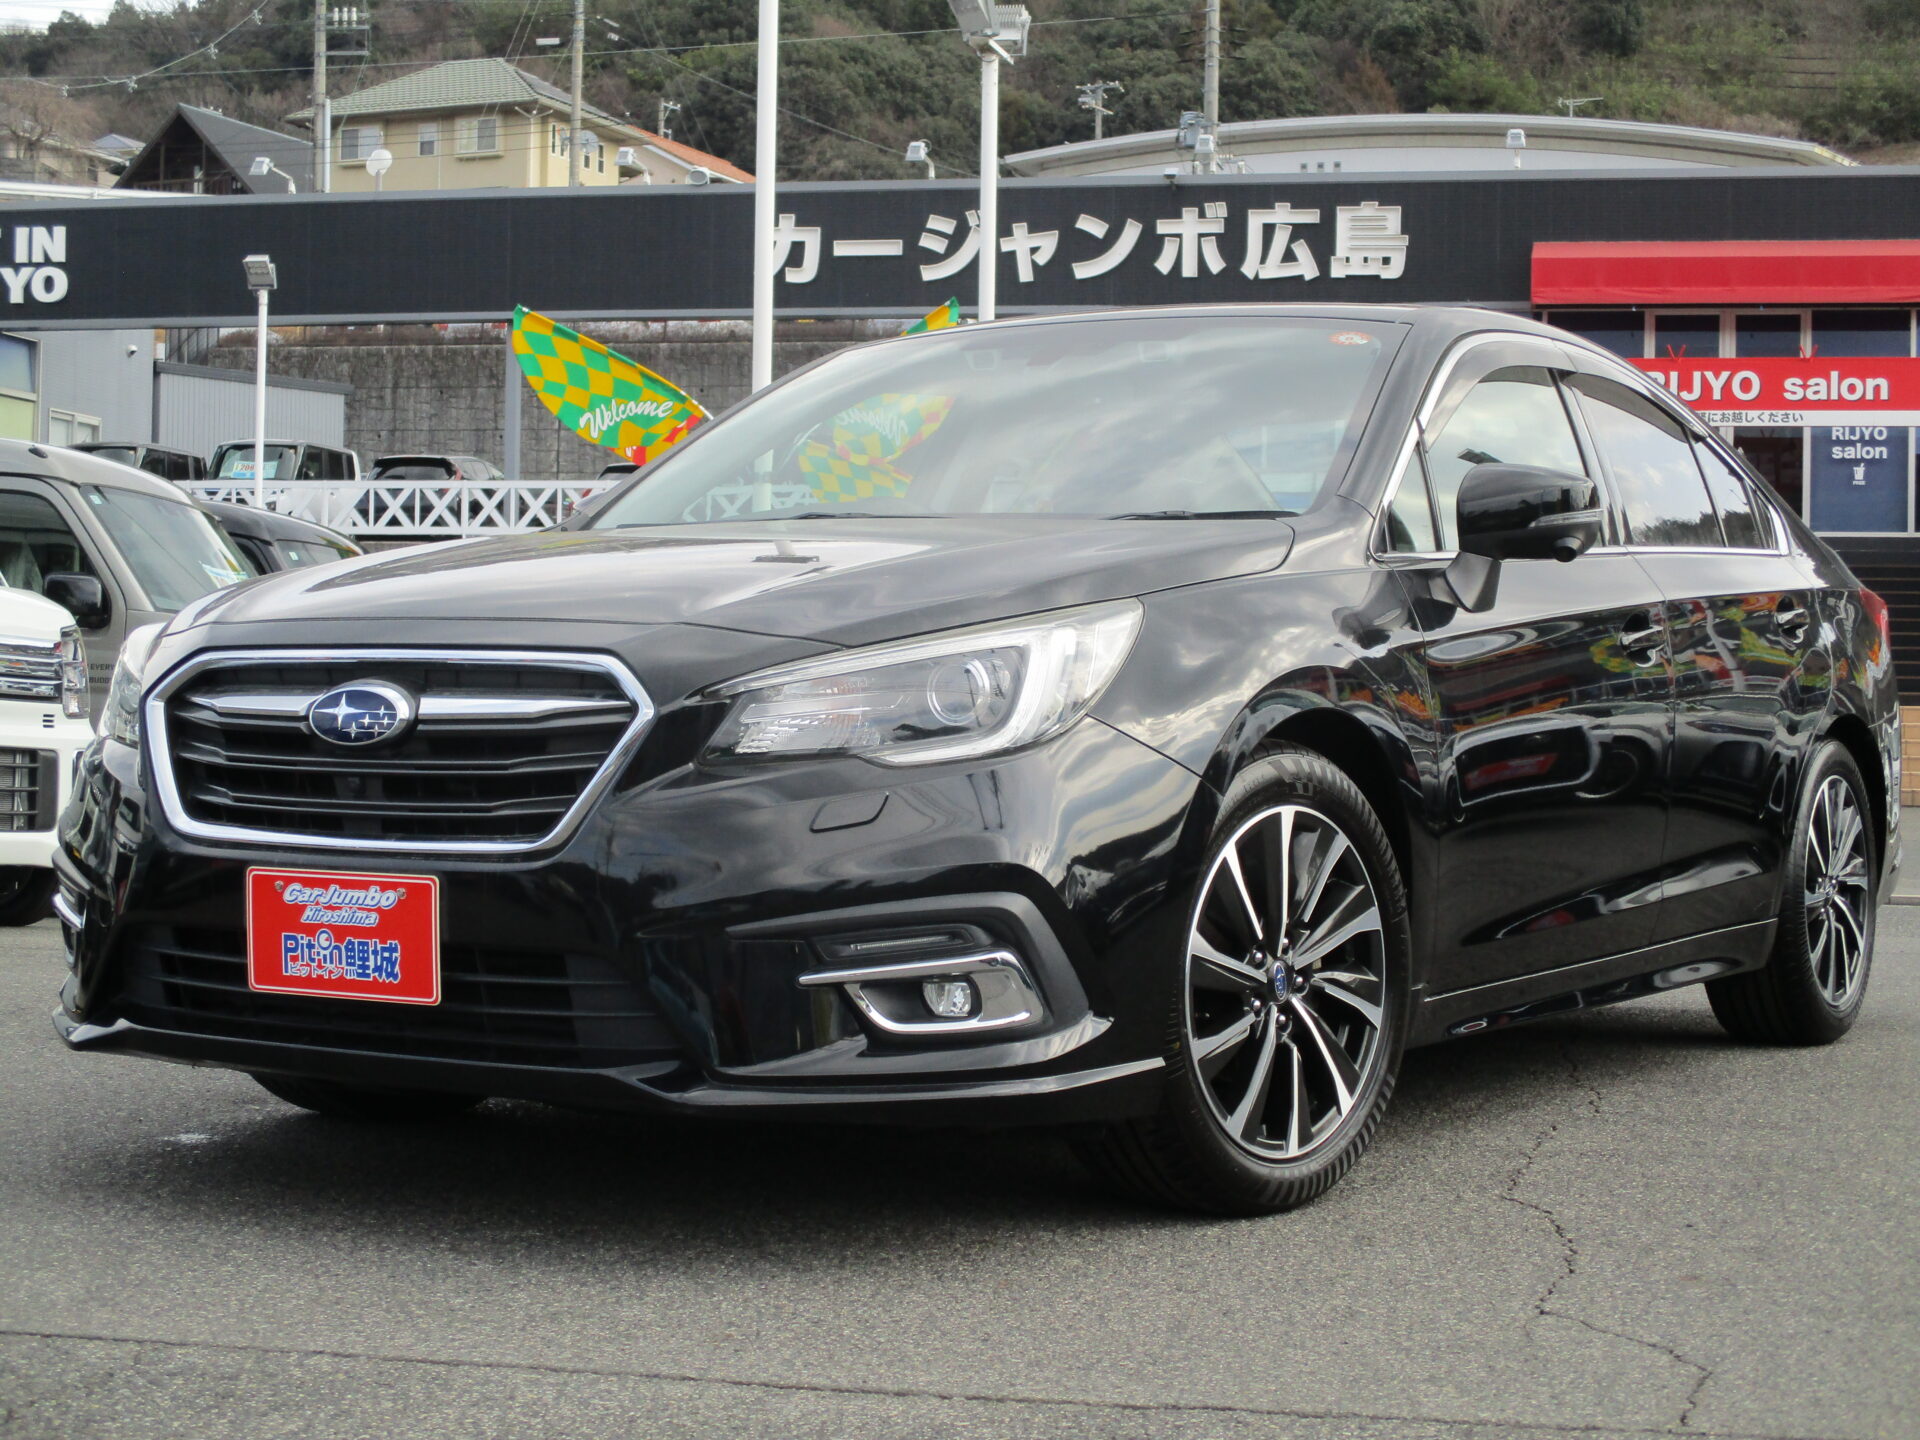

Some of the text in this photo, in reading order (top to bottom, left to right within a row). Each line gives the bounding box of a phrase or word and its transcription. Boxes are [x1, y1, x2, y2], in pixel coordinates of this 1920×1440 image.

[15, 226, 67, 263] IN
[773, 201, 1409, 284] カージャンボ広島
[1783, 371, 1890, 401] salon
[579, 398, 675, 439] Welcome
[1831, 426, 1887, 440] RIJYO
[1831, 443, 1888, 460] salon
[301, 905, 379, 927] Hiroshima
